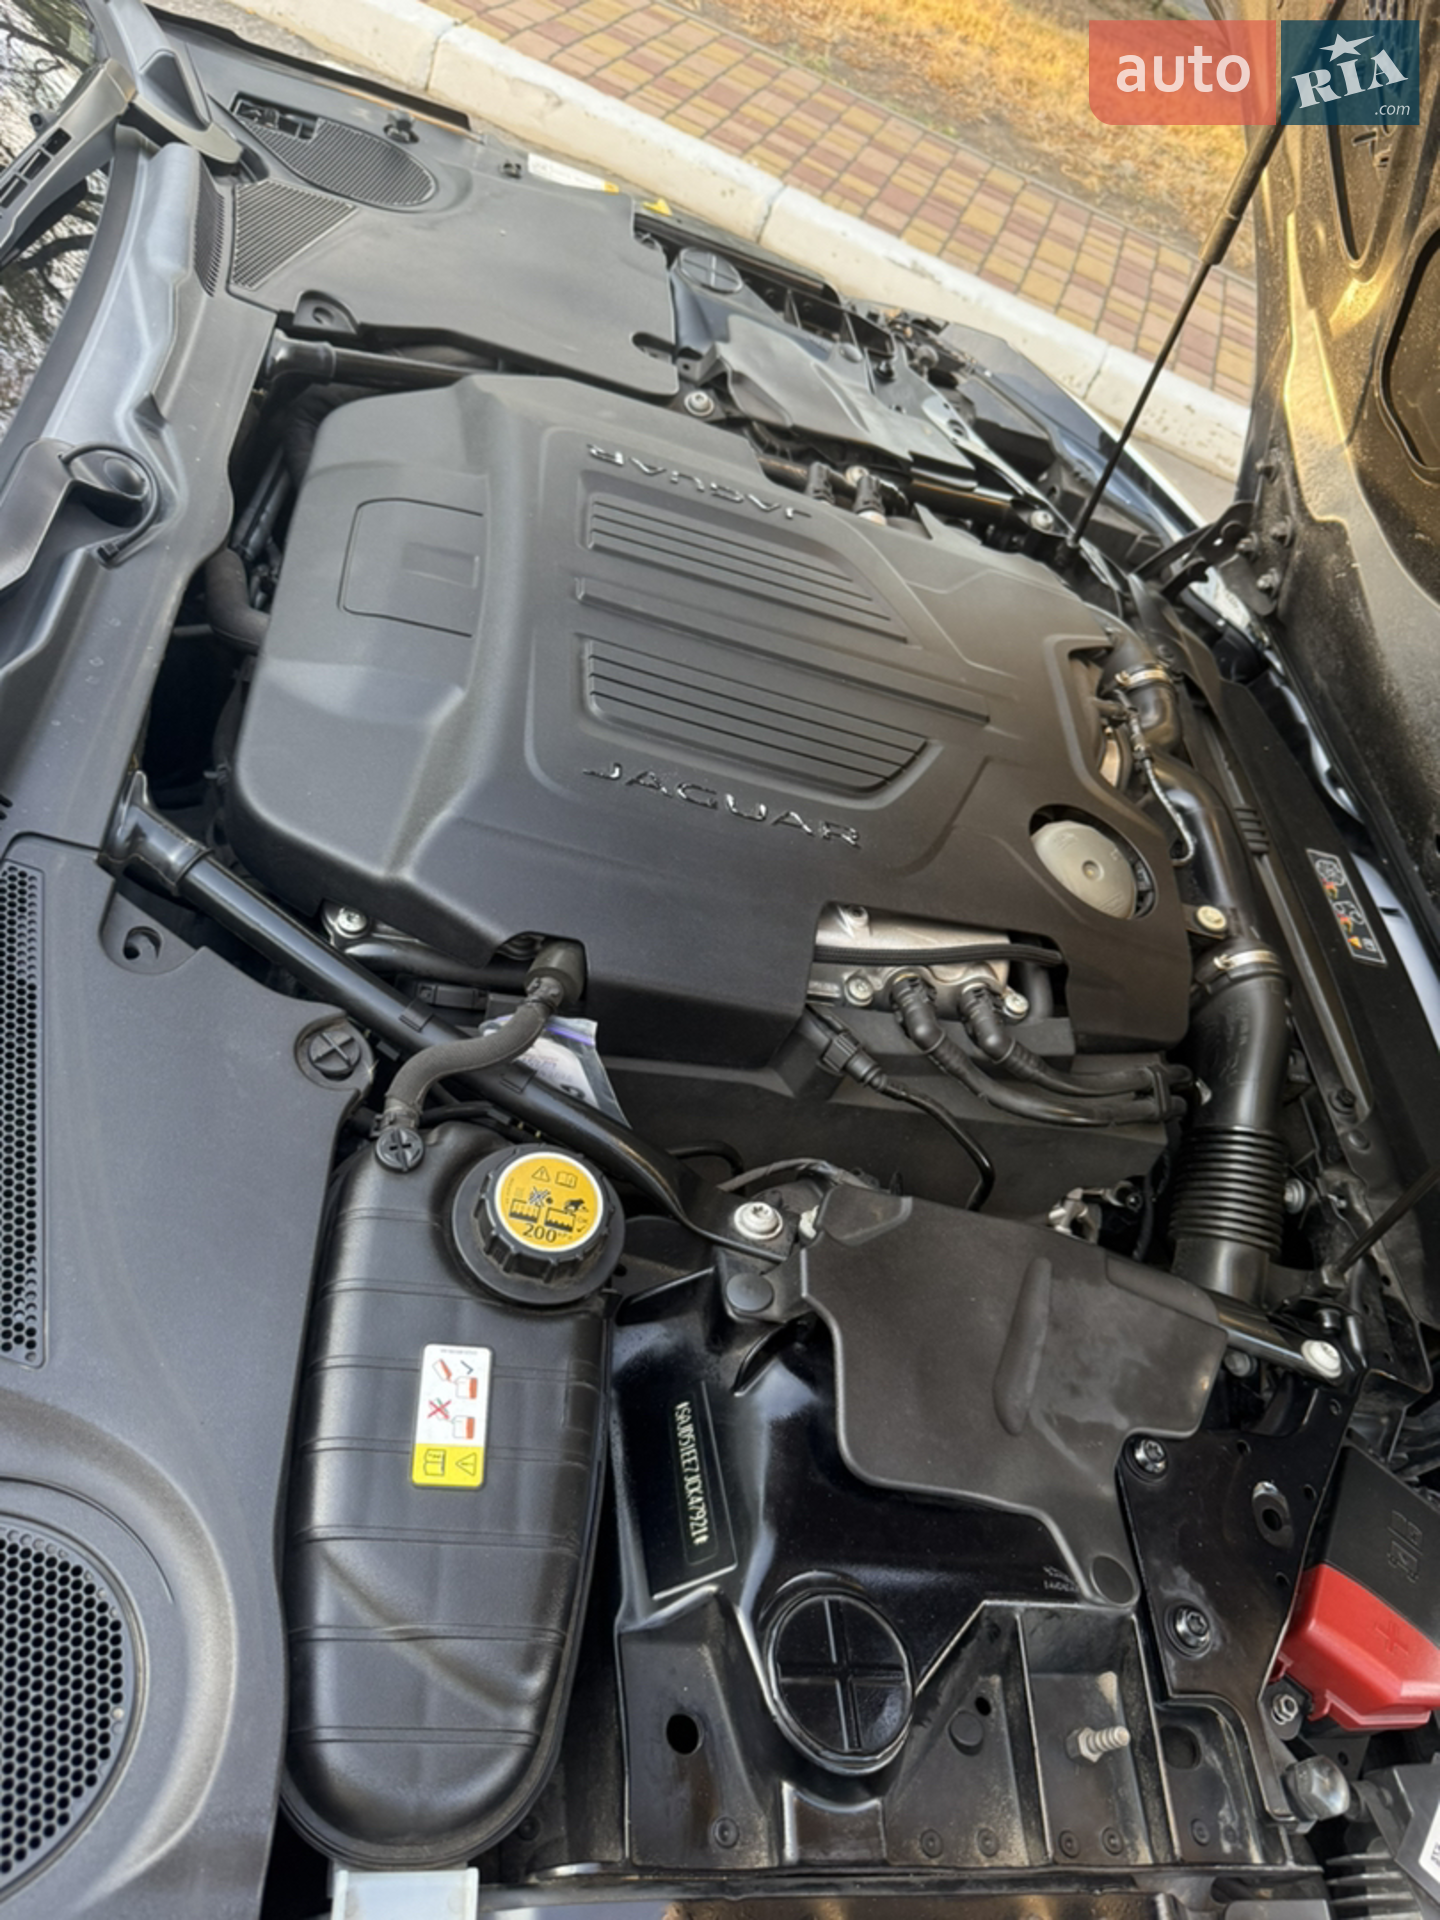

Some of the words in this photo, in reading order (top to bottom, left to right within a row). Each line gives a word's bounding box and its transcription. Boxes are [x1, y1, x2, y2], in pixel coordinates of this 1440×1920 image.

[587, 443, 813, 520] JAGUAR
[582, 762, 861, 849] JAGUAR
[523, 1223, 557, 1243] 200
